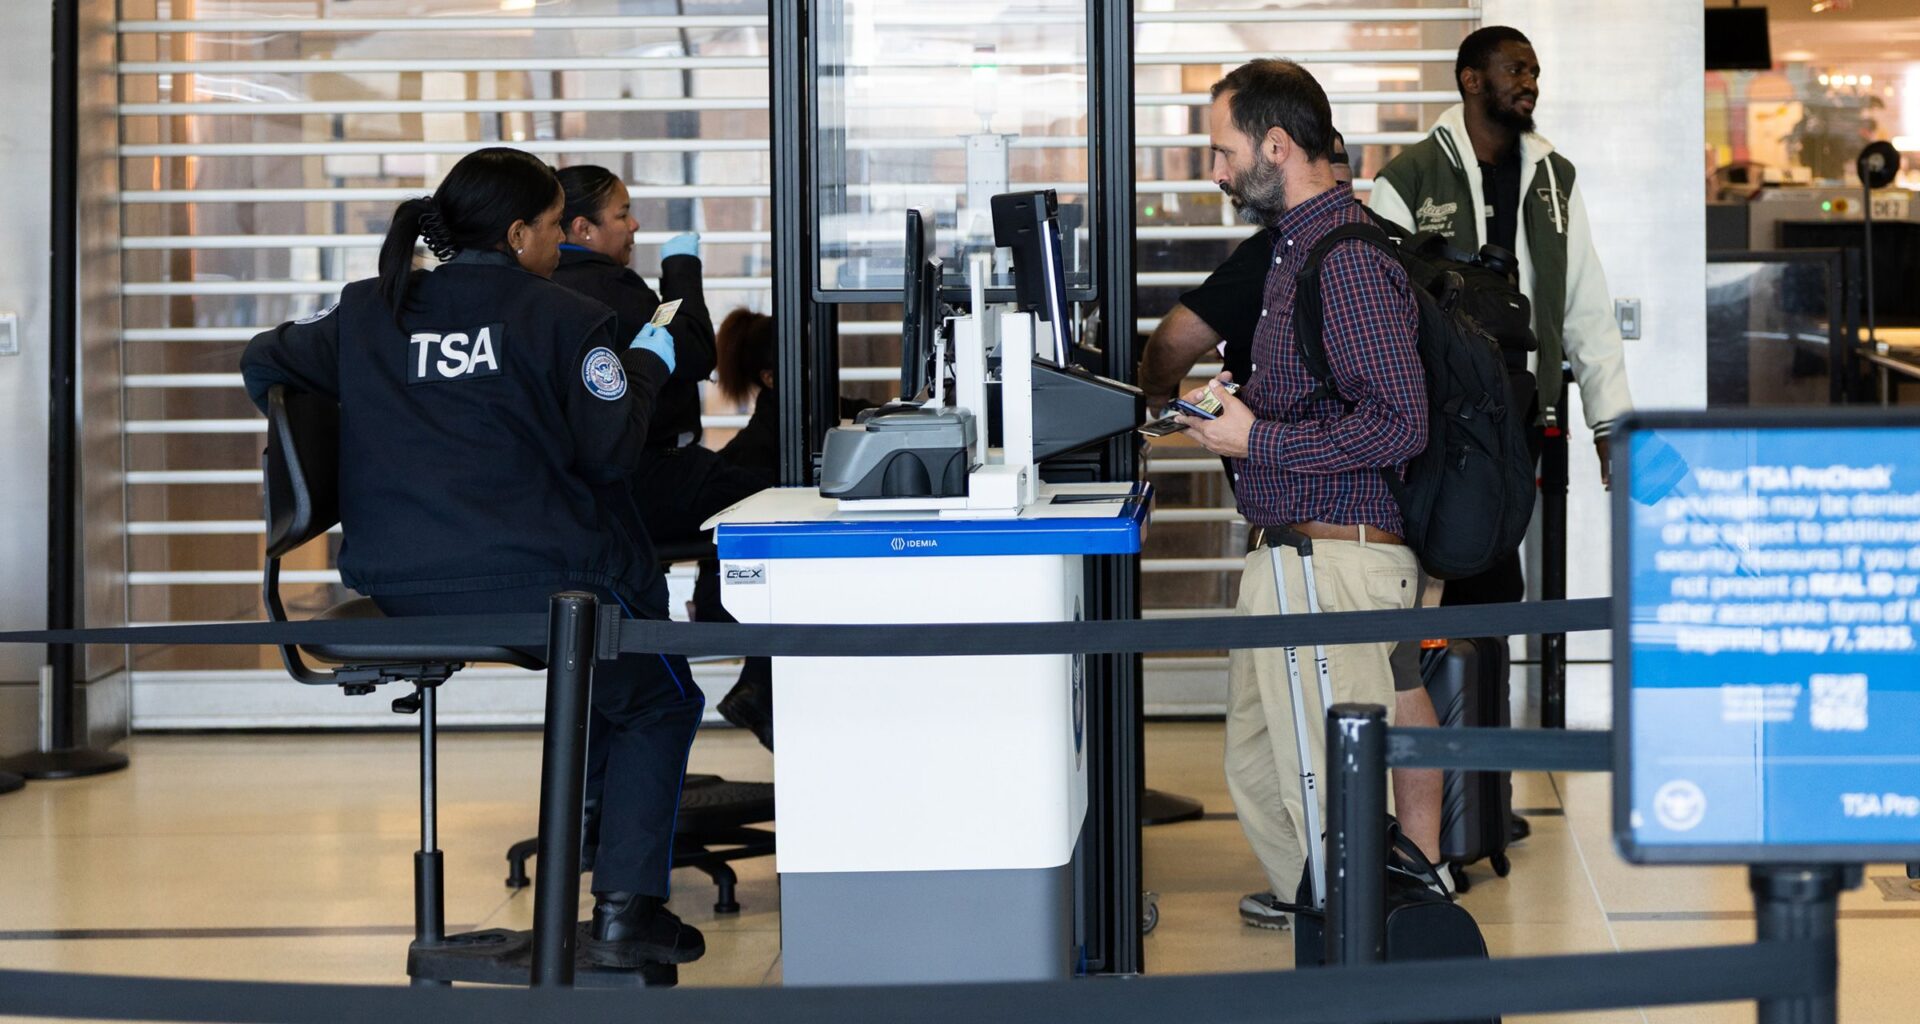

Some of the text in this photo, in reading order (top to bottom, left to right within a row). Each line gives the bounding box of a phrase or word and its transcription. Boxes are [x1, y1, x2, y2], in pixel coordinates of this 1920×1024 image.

[410, 327, 498, 378] TSA
[1694, 467, 1744, 490] Your
[1748, 466, 1790, 490] TSA
[1666, 495, 1768, 520] privileges
[1771, 496, 1818, 520] may
[1820, 493, 1849, 516] be
[906, 539, 938, 548] IDEMIA
[1661, 523, 1686, 544] or
[1689, 521, 1718, 544] be
[1720, 521, 1796, 545] subject
[1797, 521, 1823, 544] to
[1655, 548, 1738, 573] security
[1741, 549, 1841, 571] measures
[1843, 545, 1862, 570] if
[1863, 549, 1905, 573] you
[726, 569, 762, 579] GCX
[1671, 572, 1919, 600] not present a REAL ID or
[1657, 600, 1714, 623] other
[1716, 601, 1827, 624] acceptable
[1828, 599, 1882, 623] form
[1882, 599, 1907, 623] of
[1677, 626, 1780, 654] beginning
[1781, 626, 1831, 654] May
[1831, 626, 1855, 652] 7,
[1841, 792, 1881, 817] TSA
